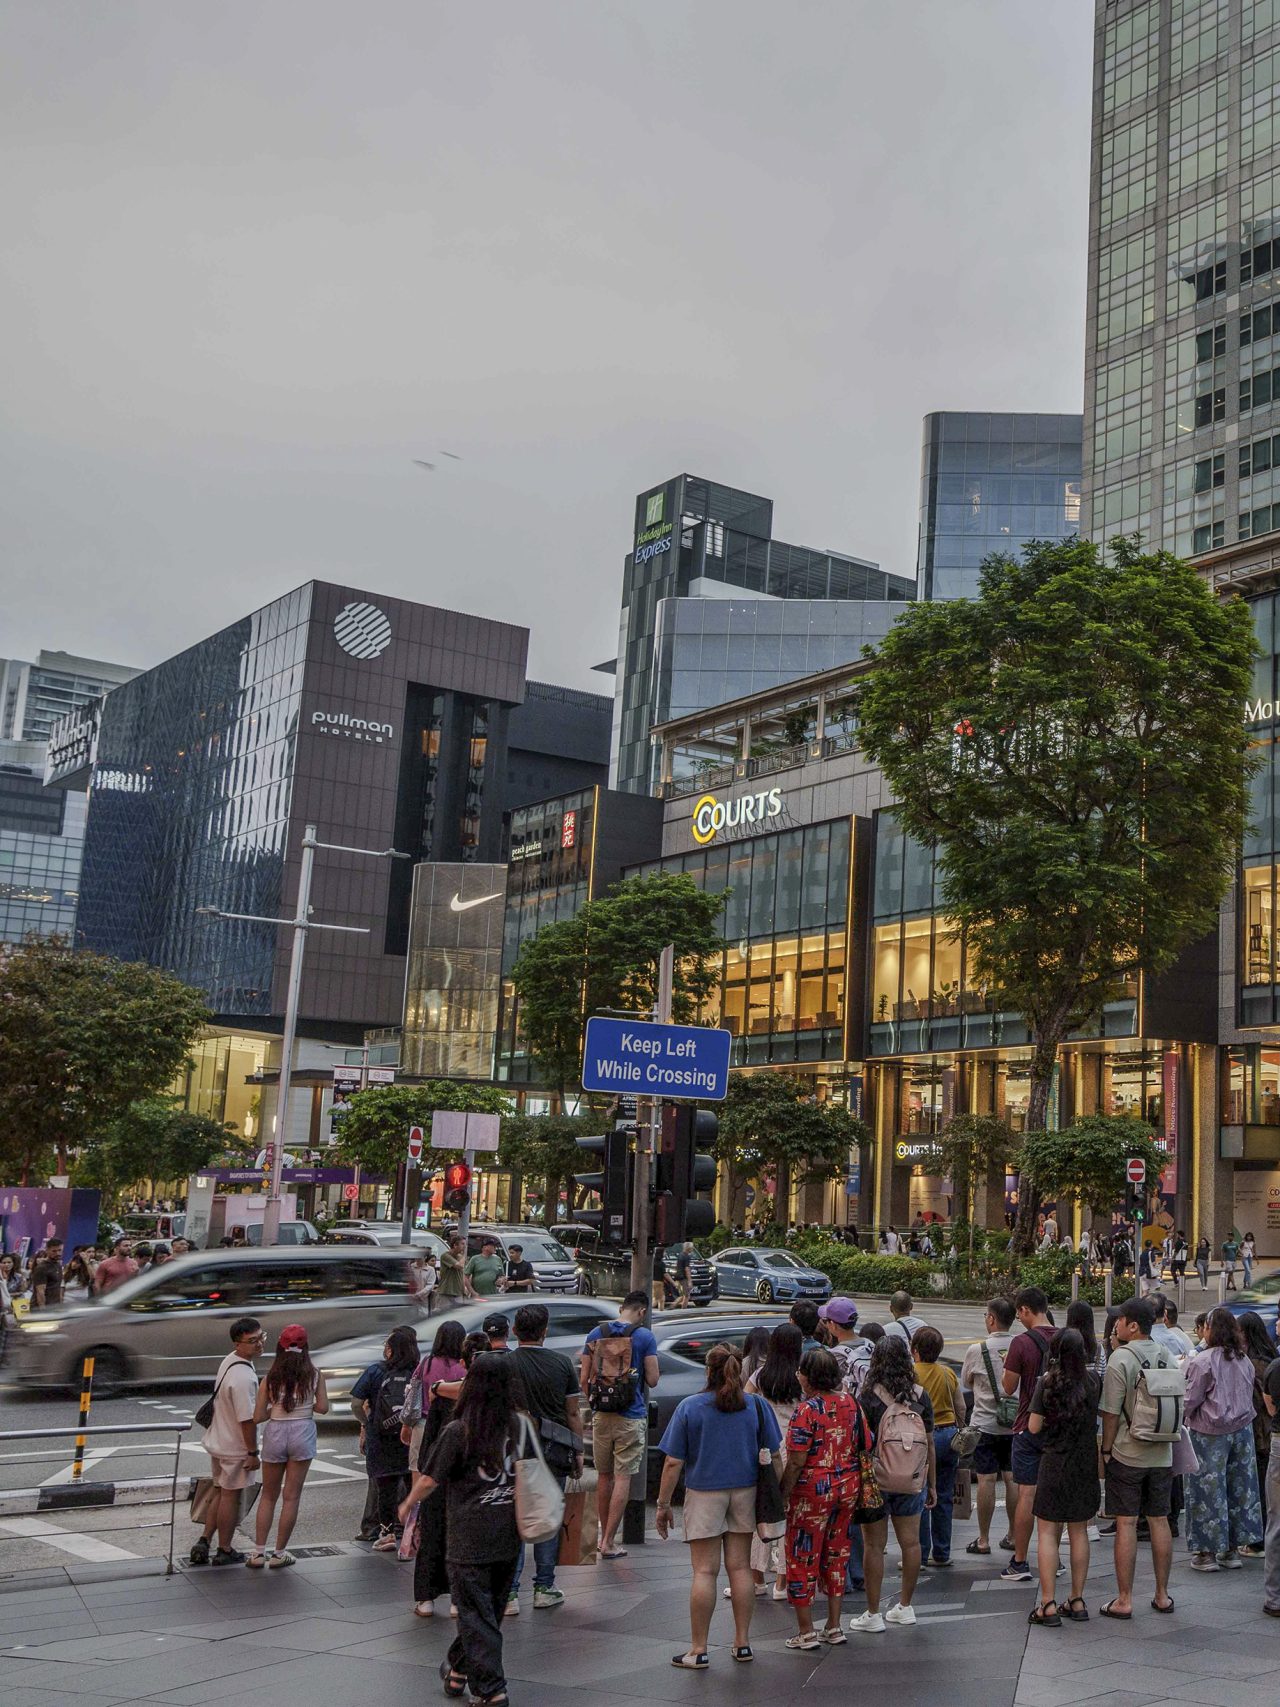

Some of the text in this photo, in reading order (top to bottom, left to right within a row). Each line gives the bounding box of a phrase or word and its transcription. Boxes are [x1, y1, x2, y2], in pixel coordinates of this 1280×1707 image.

[635, 536, 673, 565] Express
[311, 711, 393, 738] pullman
[320, 726, 383, 743] HOTELS
[697, 788, 782, 836] COURTS
[511, 841, 542, 857] peach garden
[621, 1033, 697, 1059] Keep Left
[597, 1059, 717, 1092] While Crossing
